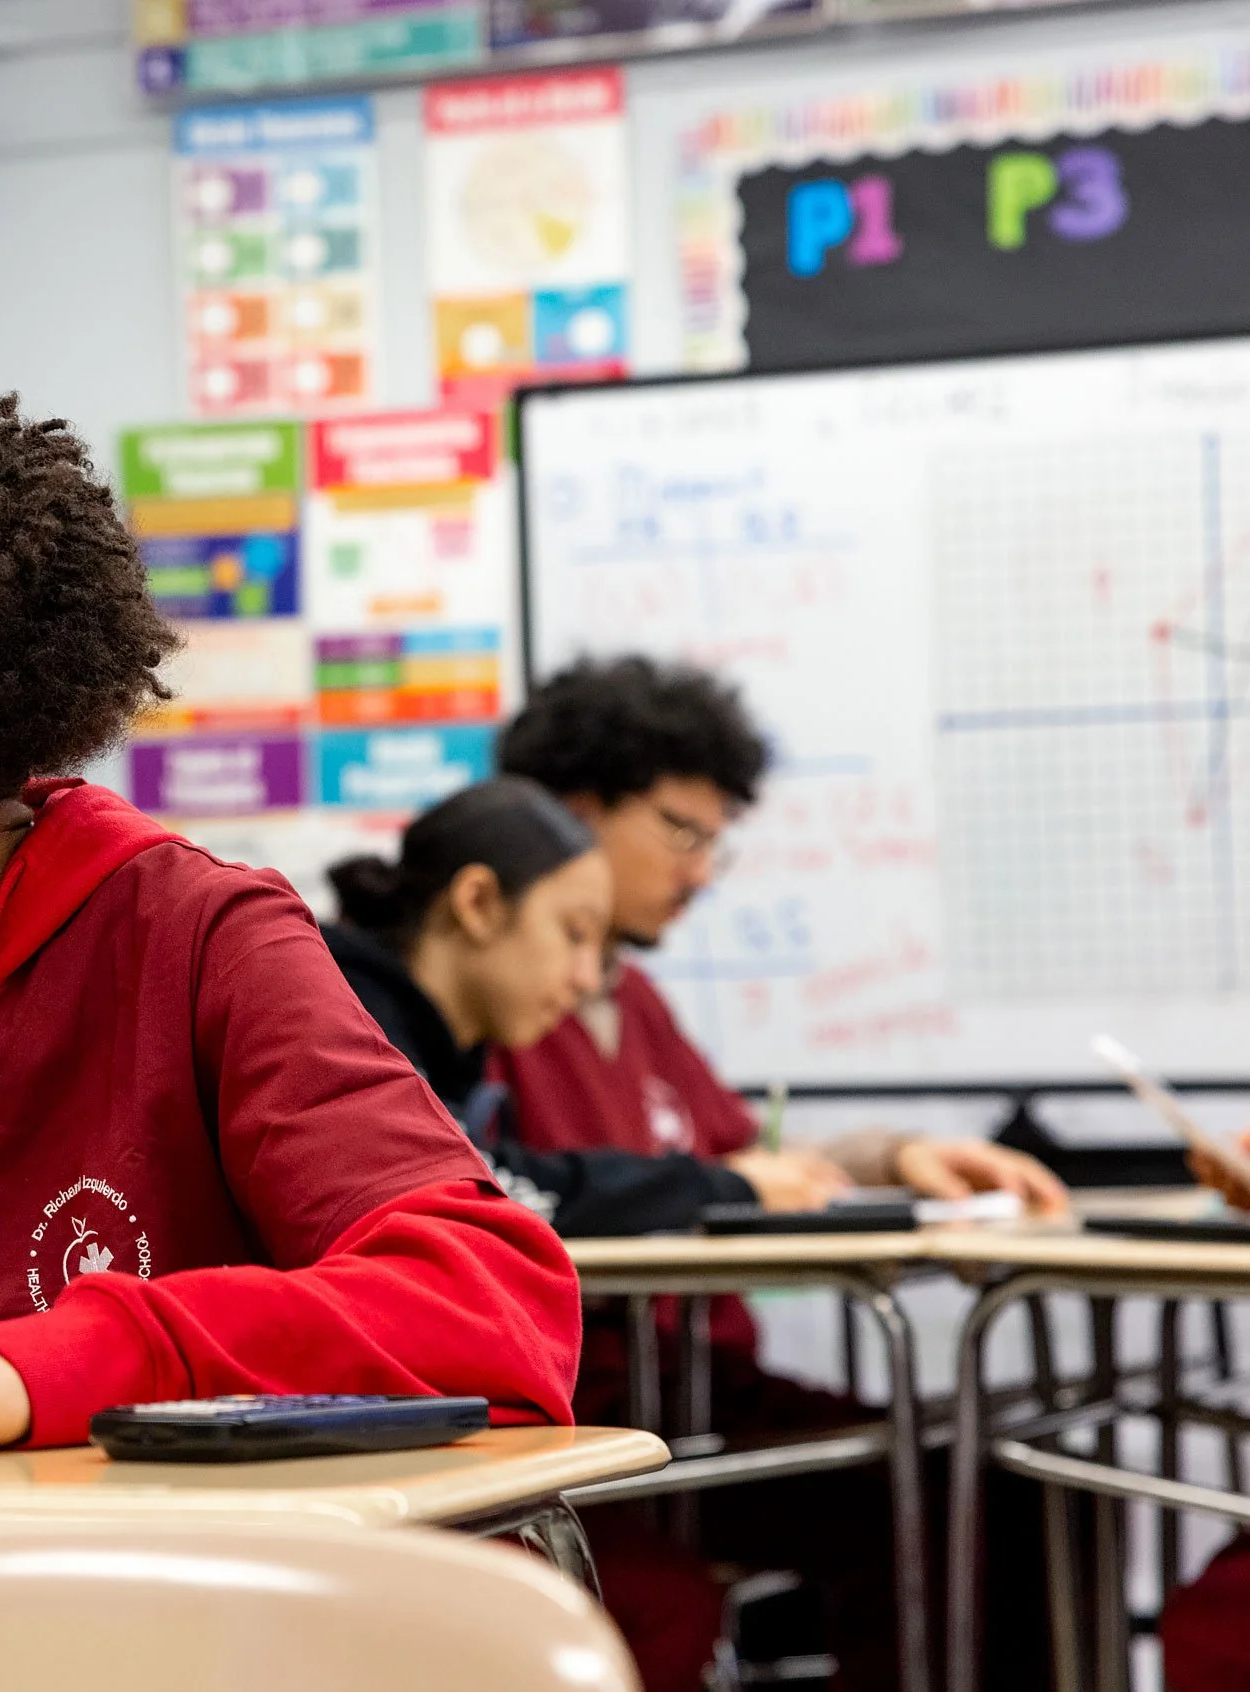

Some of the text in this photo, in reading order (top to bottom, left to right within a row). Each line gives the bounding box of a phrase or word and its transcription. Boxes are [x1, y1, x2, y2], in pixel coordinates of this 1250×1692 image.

[787, 176, 903, 278] P1
[987, 145, 1130, 250] P3
[31, 1222, 48, 1241] Dr.
[82, 1174, 128, 1211] Izquierdo
[135, 1231, 151, 1282] CHOOL
